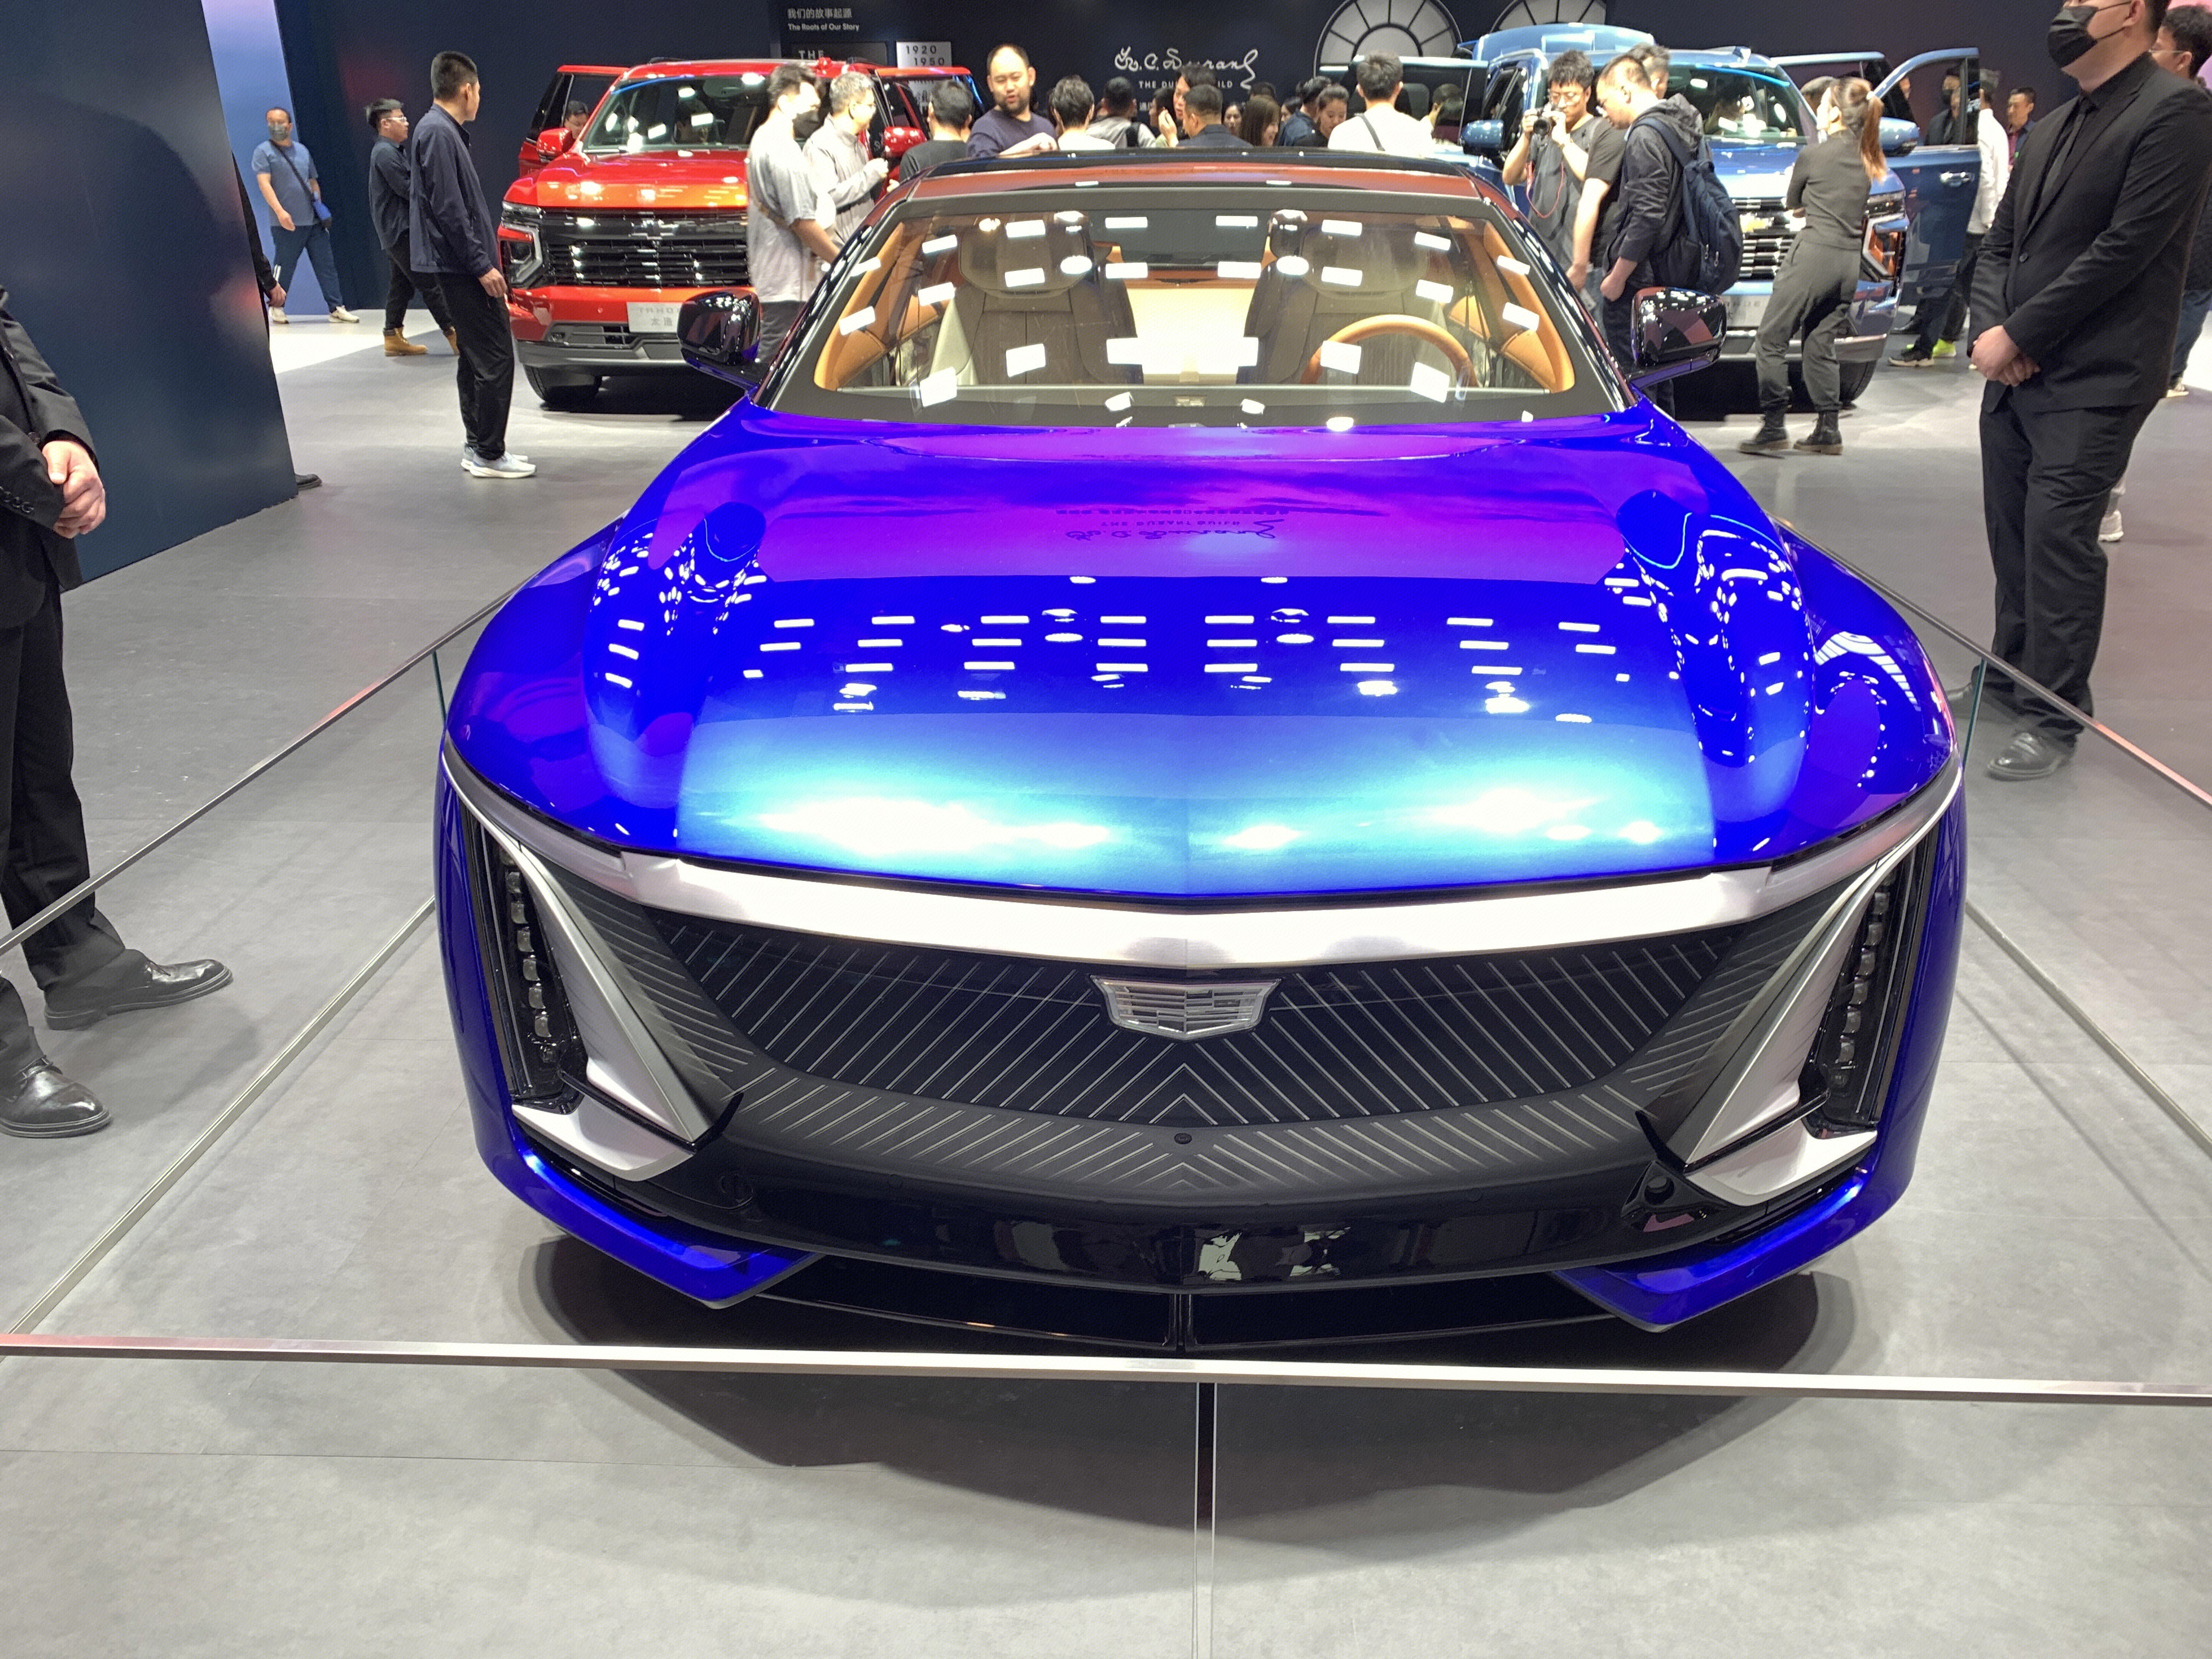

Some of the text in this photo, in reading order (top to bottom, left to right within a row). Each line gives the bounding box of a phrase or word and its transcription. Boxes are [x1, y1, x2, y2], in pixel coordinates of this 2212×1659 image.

[787, 7, 853, 19] 我们的故事起源
[843, 23, 860, 32] Story
[906, 45, 936, 54] 1920
[914, 57, 945, 66] 1950
[1139, 80, 1156, 89] THE
